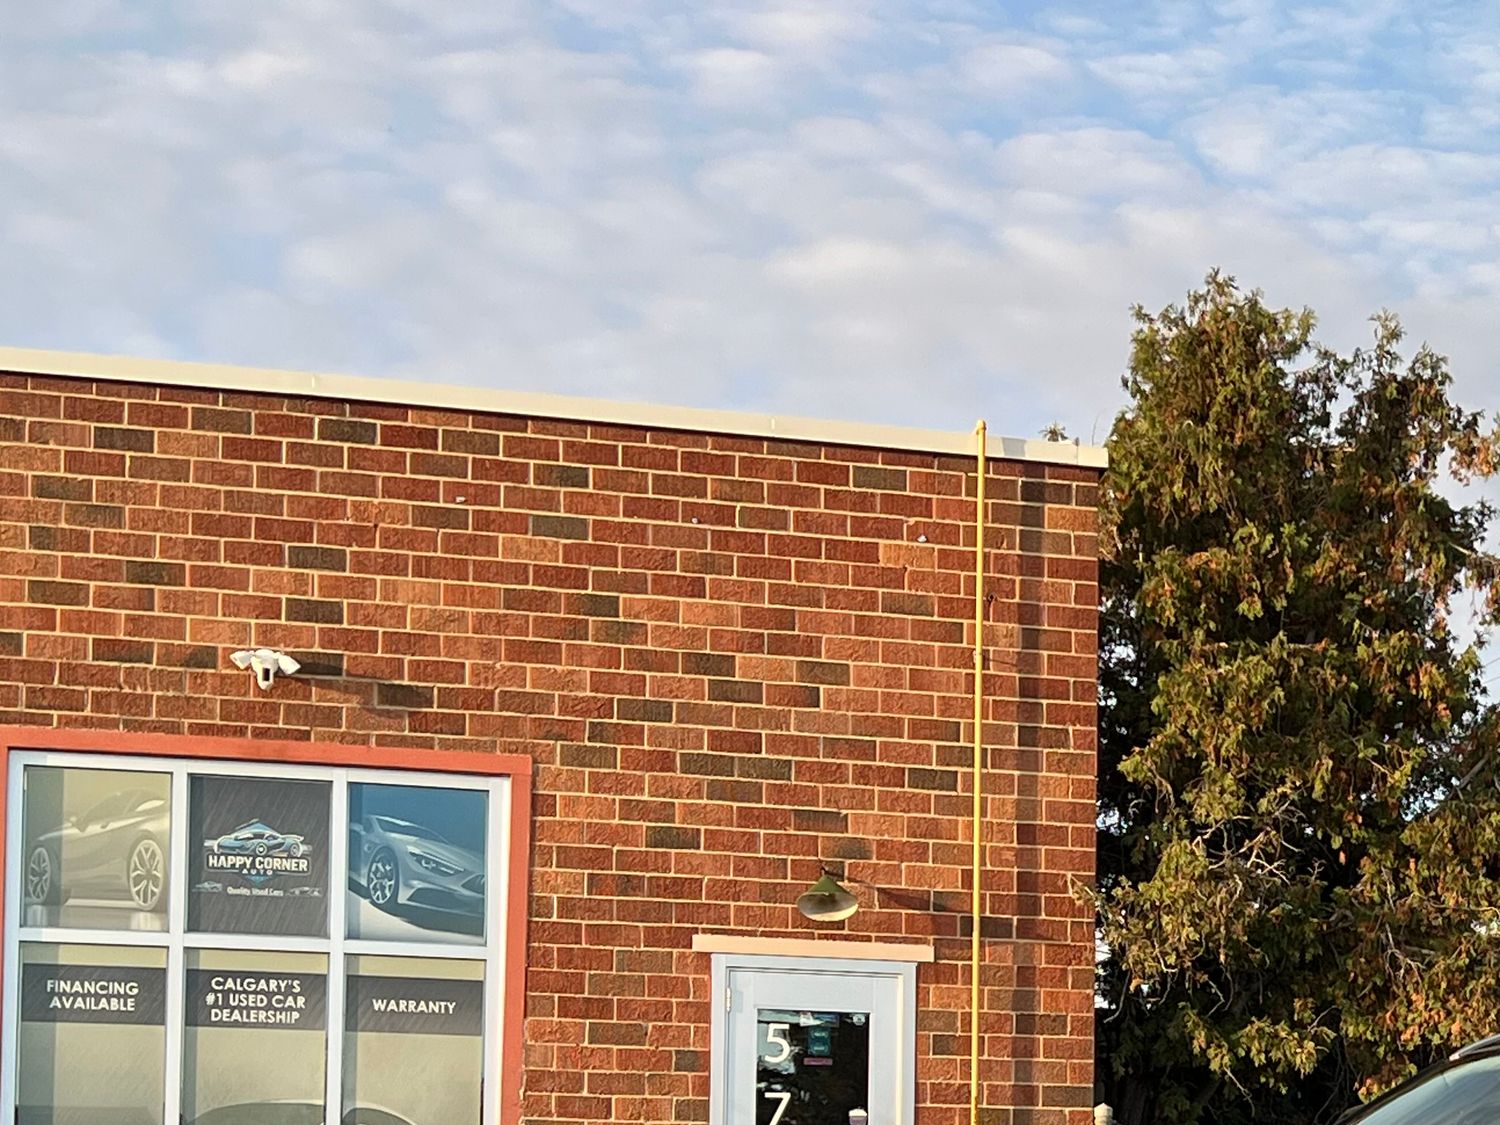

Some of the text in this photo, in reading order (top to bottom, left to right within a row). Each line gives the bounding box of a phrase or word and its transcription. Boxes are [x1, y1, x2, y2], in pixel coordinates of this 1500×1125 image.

[208, 855, 308, 872] HAPPY CORNER
[242, 868, 273, 876] AUTO
[46, 979, 139, 996] FINANCING
[211, 977, 301, 993] CALGARY'S
[49, 996, 135, 1011] AVAILABLE
[205, 992, 306, 1009] #1 USED CAR
[372, 998, 456, 1015] WARRANTY
[210, 1009, 300, 1024] DEALERSHIP
